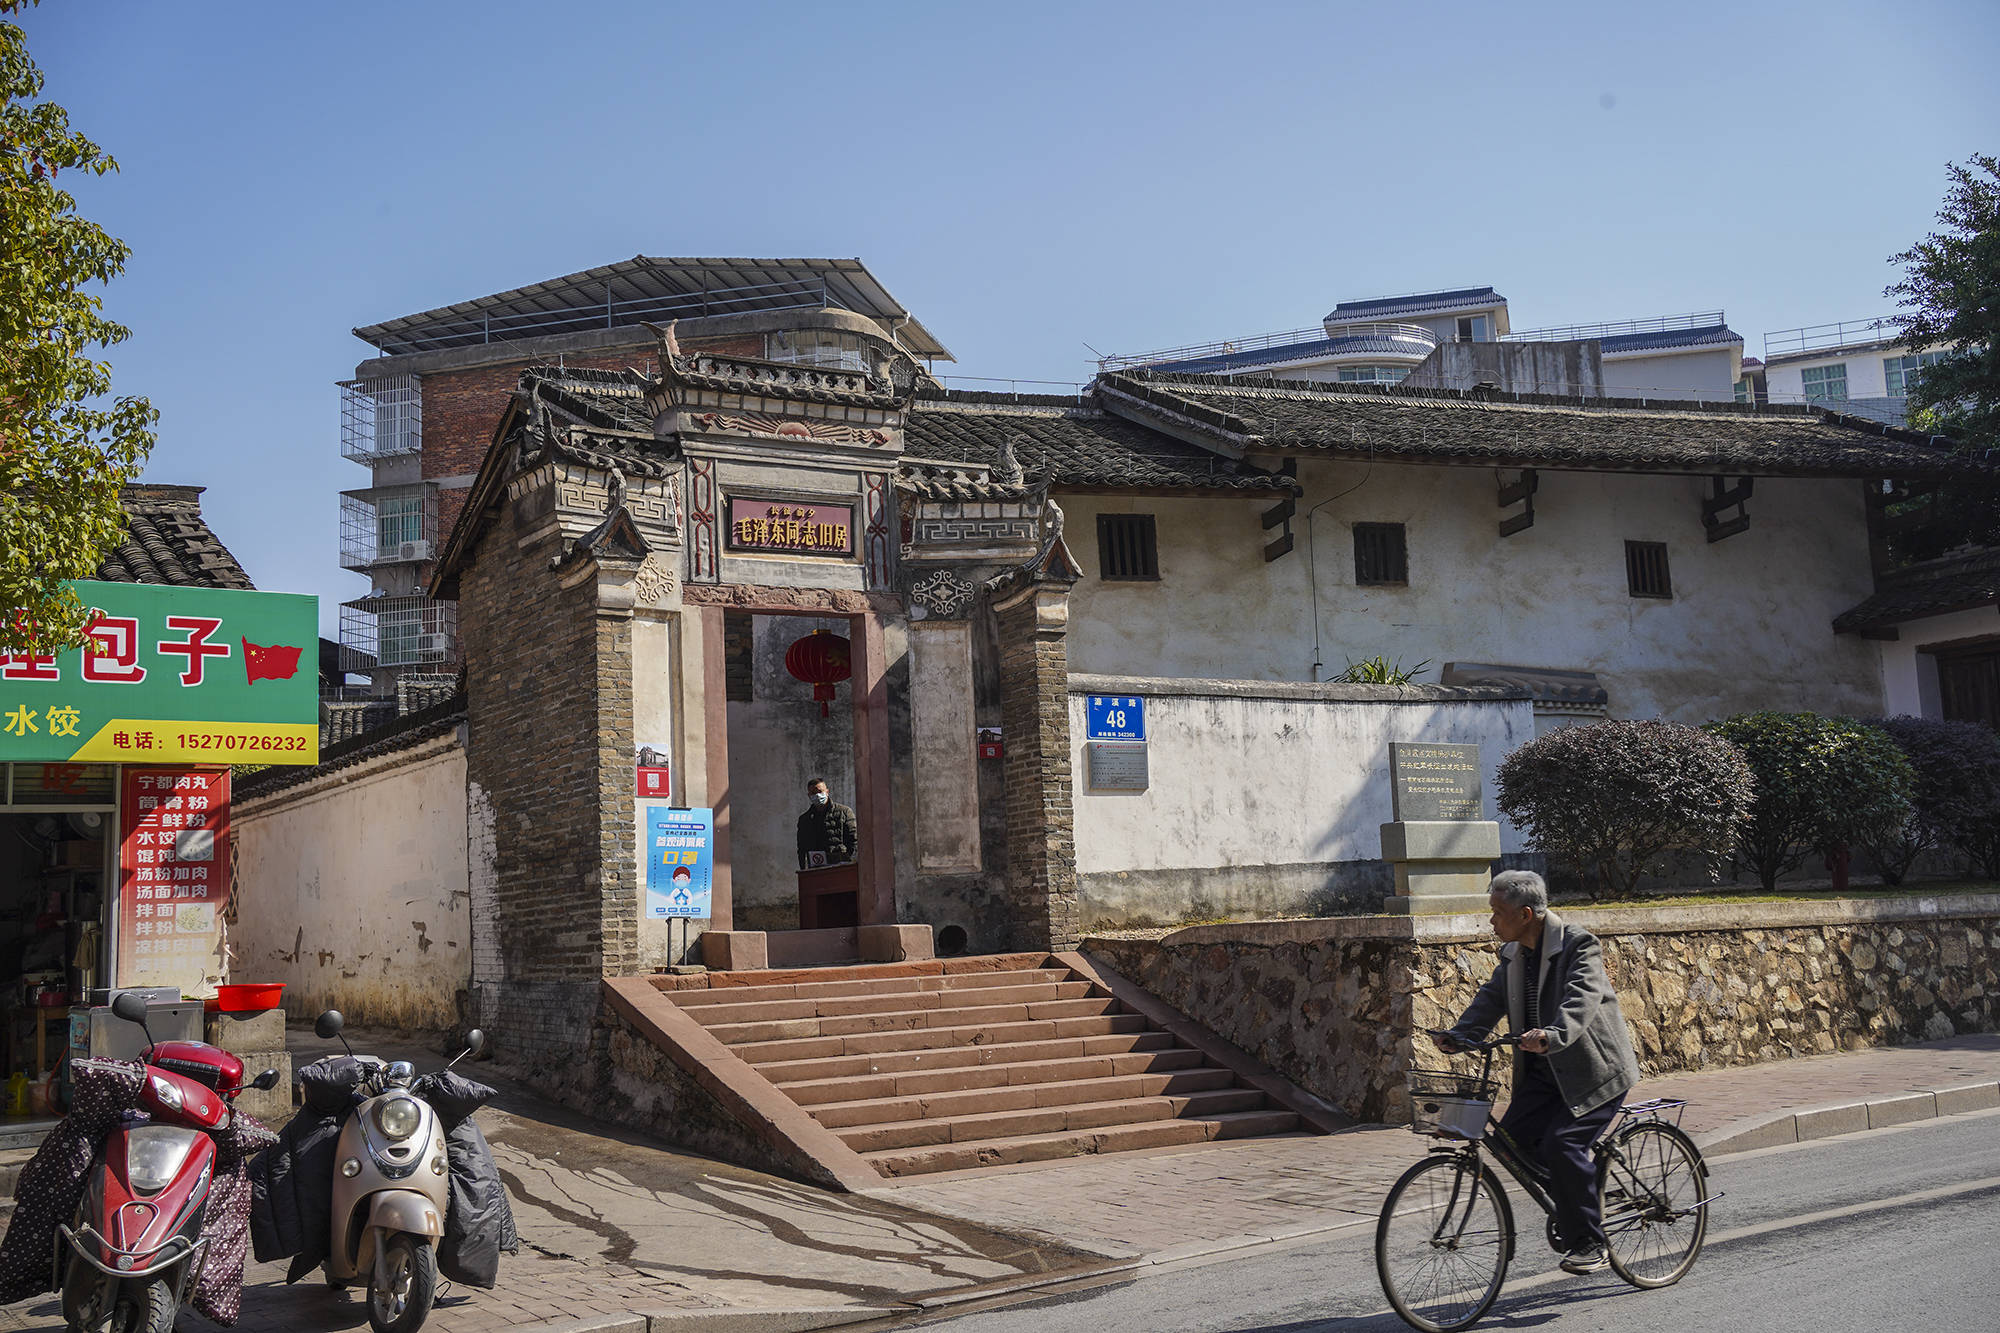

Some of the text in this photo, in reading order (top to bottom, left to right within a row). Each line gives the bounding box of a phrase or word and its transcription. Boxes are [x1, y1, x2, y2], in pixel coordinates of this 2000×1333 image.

[737, 517, 848, 548] 毛泽东同志旧居
[4, 704, 81, 737] 水饺
[1106, 710, 1126, 728] 48
[177, 733, 307, 751] 15270726232
[137, 776, 209, 790] 宁都肉丸
[138, 796, 209, 810] 筒骨粉
[138, 814, 207, 827] 三鲜粉
[137, 831, 176, 845] 水饺
[136, 849, 175, 863] 馄饨
[662, 851, 698, 865] 口罩
[136, 867, 208, 881] 汤粉加肉
[136, 885, 208, 900] 汤面加肉
[135, 903, 174, 918] 拌面
[135, 921, 174, 936] 拌粉
